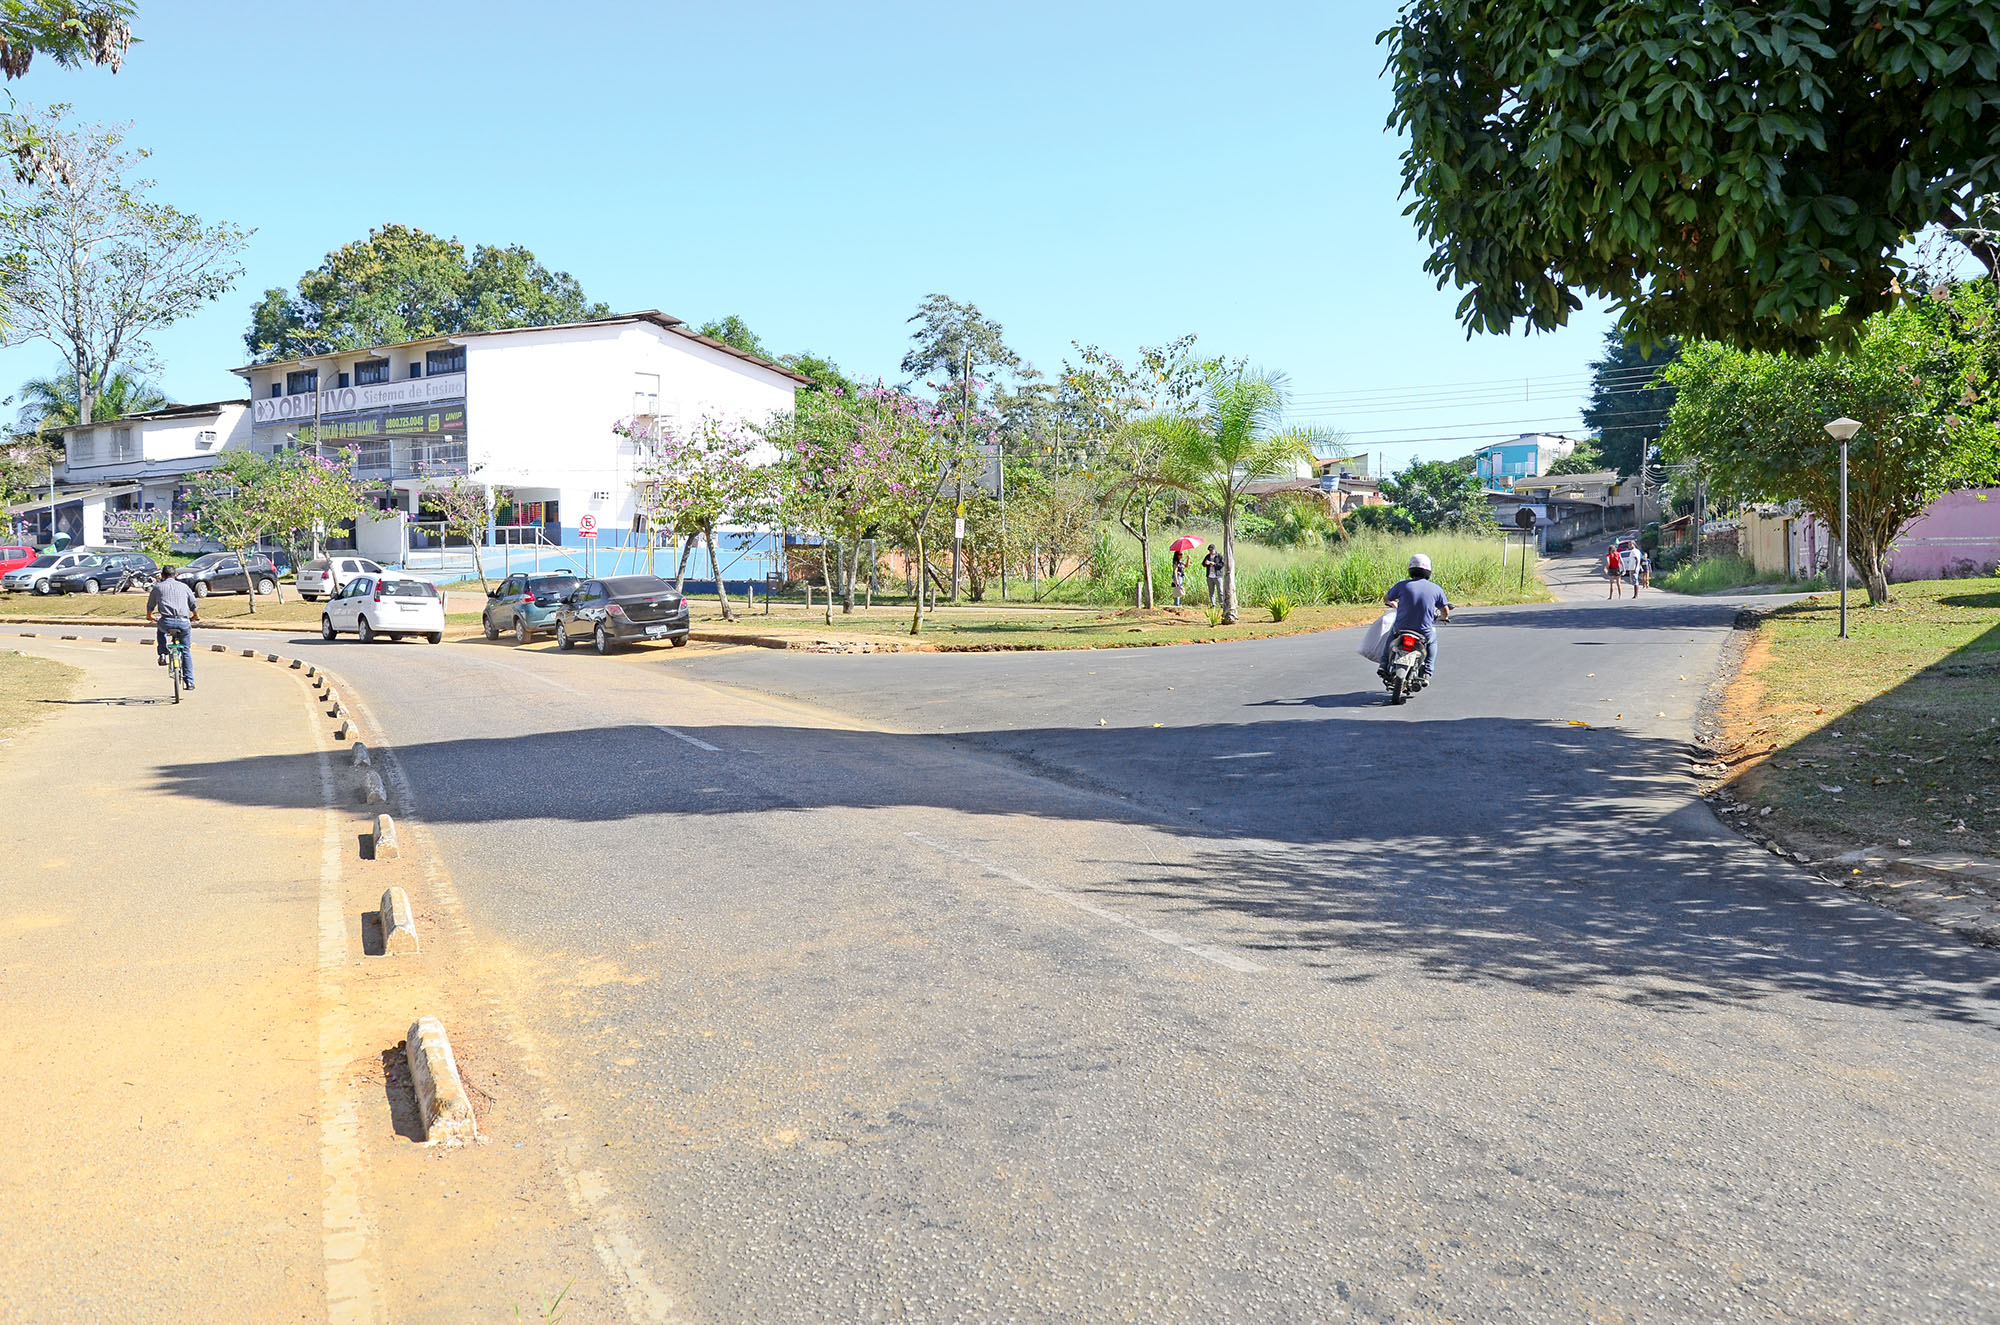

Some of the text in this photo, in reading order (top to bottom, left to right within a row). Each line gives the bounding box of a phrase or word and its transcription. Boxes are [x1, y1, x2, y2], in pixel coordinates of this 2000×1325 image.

[363, 389, 405, 404] Sistema
[409, 384, 422, 398] de
[426, 380, 463, 397] Ensino
[445, 411, 462, 421] UNIP
